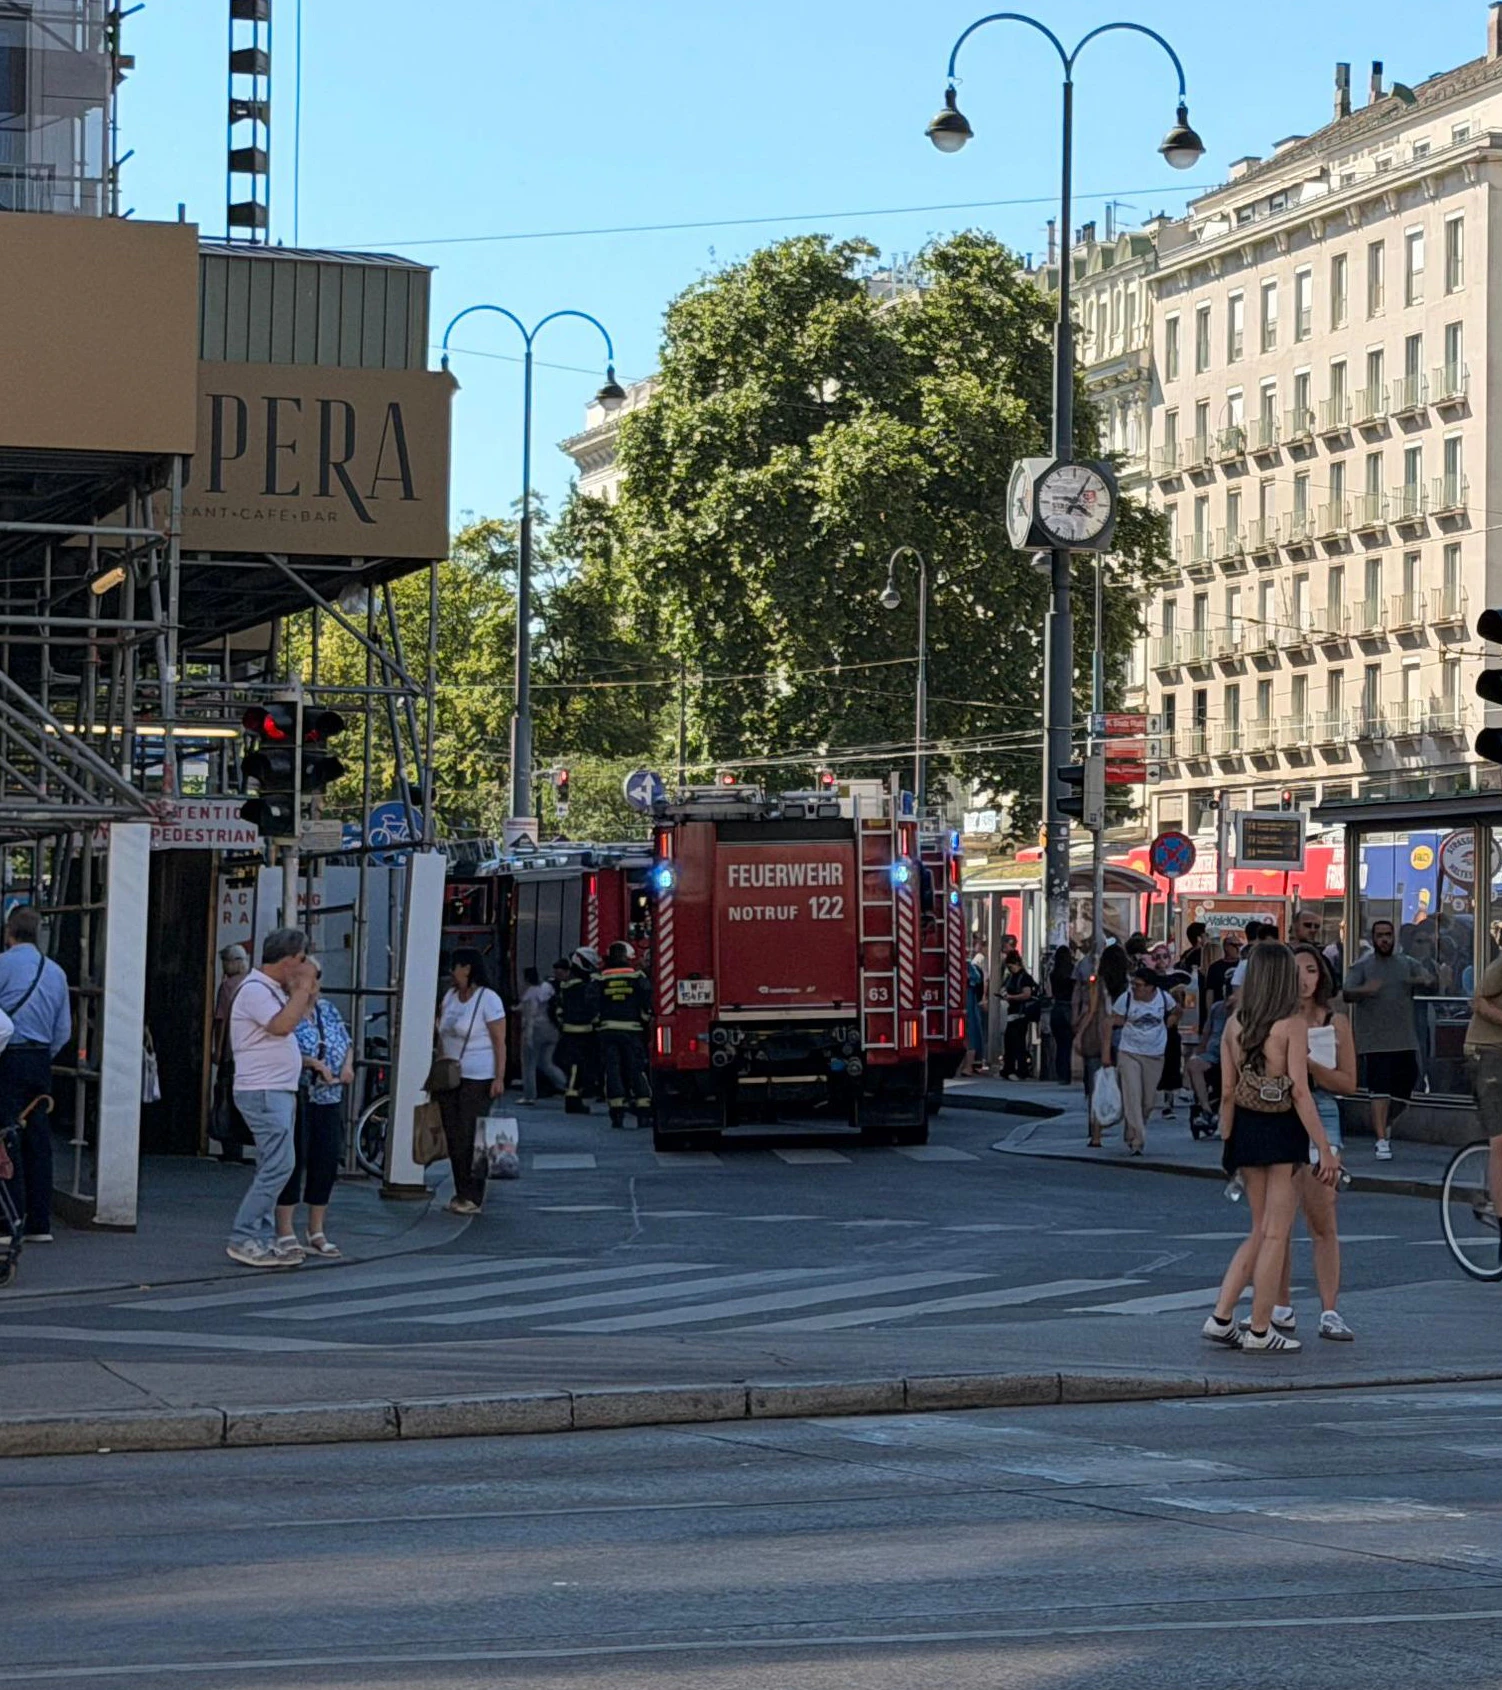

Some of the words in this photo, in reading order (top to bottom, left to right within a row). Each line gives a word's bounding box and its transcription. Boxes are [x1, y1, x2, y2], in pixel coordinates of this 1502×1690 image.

[181, 393, 422, 524] PERA
[300, 511, 338, 524] BAR
[728, 862, 844, 888] FEUERWEHR
[728, 905, 799, 921] NOTRUF
[808, 896, 844, 919] 122
[868, 987, 888, 1001] 63
